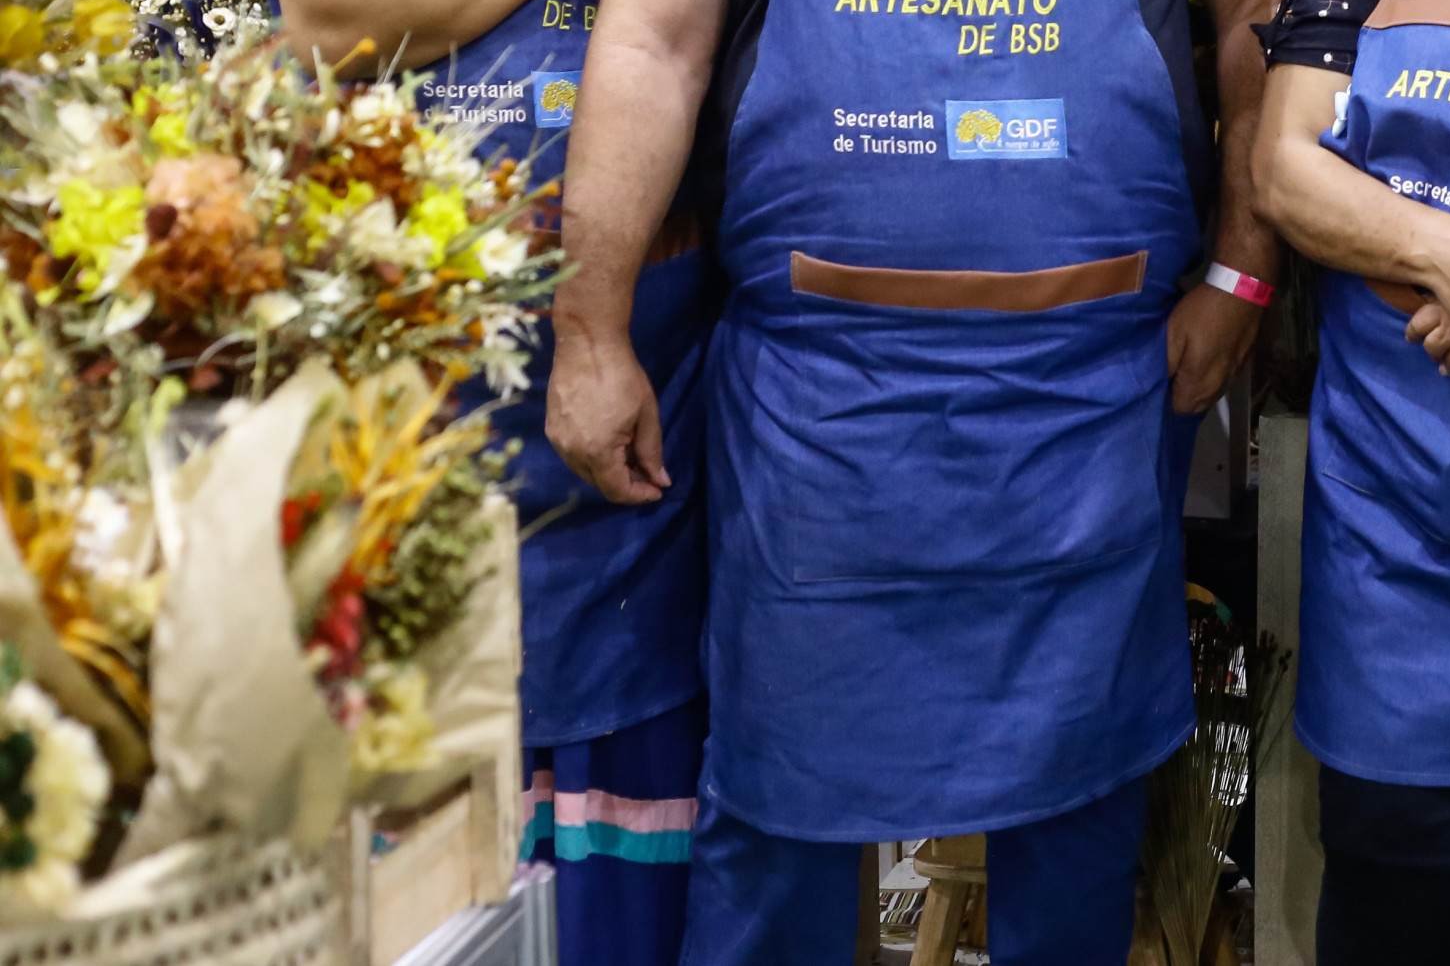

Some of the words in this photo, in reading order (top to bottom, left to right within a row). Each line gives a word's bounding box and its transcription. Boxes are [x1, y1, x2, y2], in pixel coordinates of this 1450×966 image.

[542, 0, 573, 30] DE
[957, 23, 997, 55] DE
[1009, 23, 1060, 54] BSB
[423, 80, 524, 99] Secretaria
[449, 105, 526, 123] Turismo
[833, 108, 934, 129] Secretaria
[1006, 118, 1057, 139] GDF
[833, 135, 854, 152] de
[860, 135, 937, 154] Turismo
